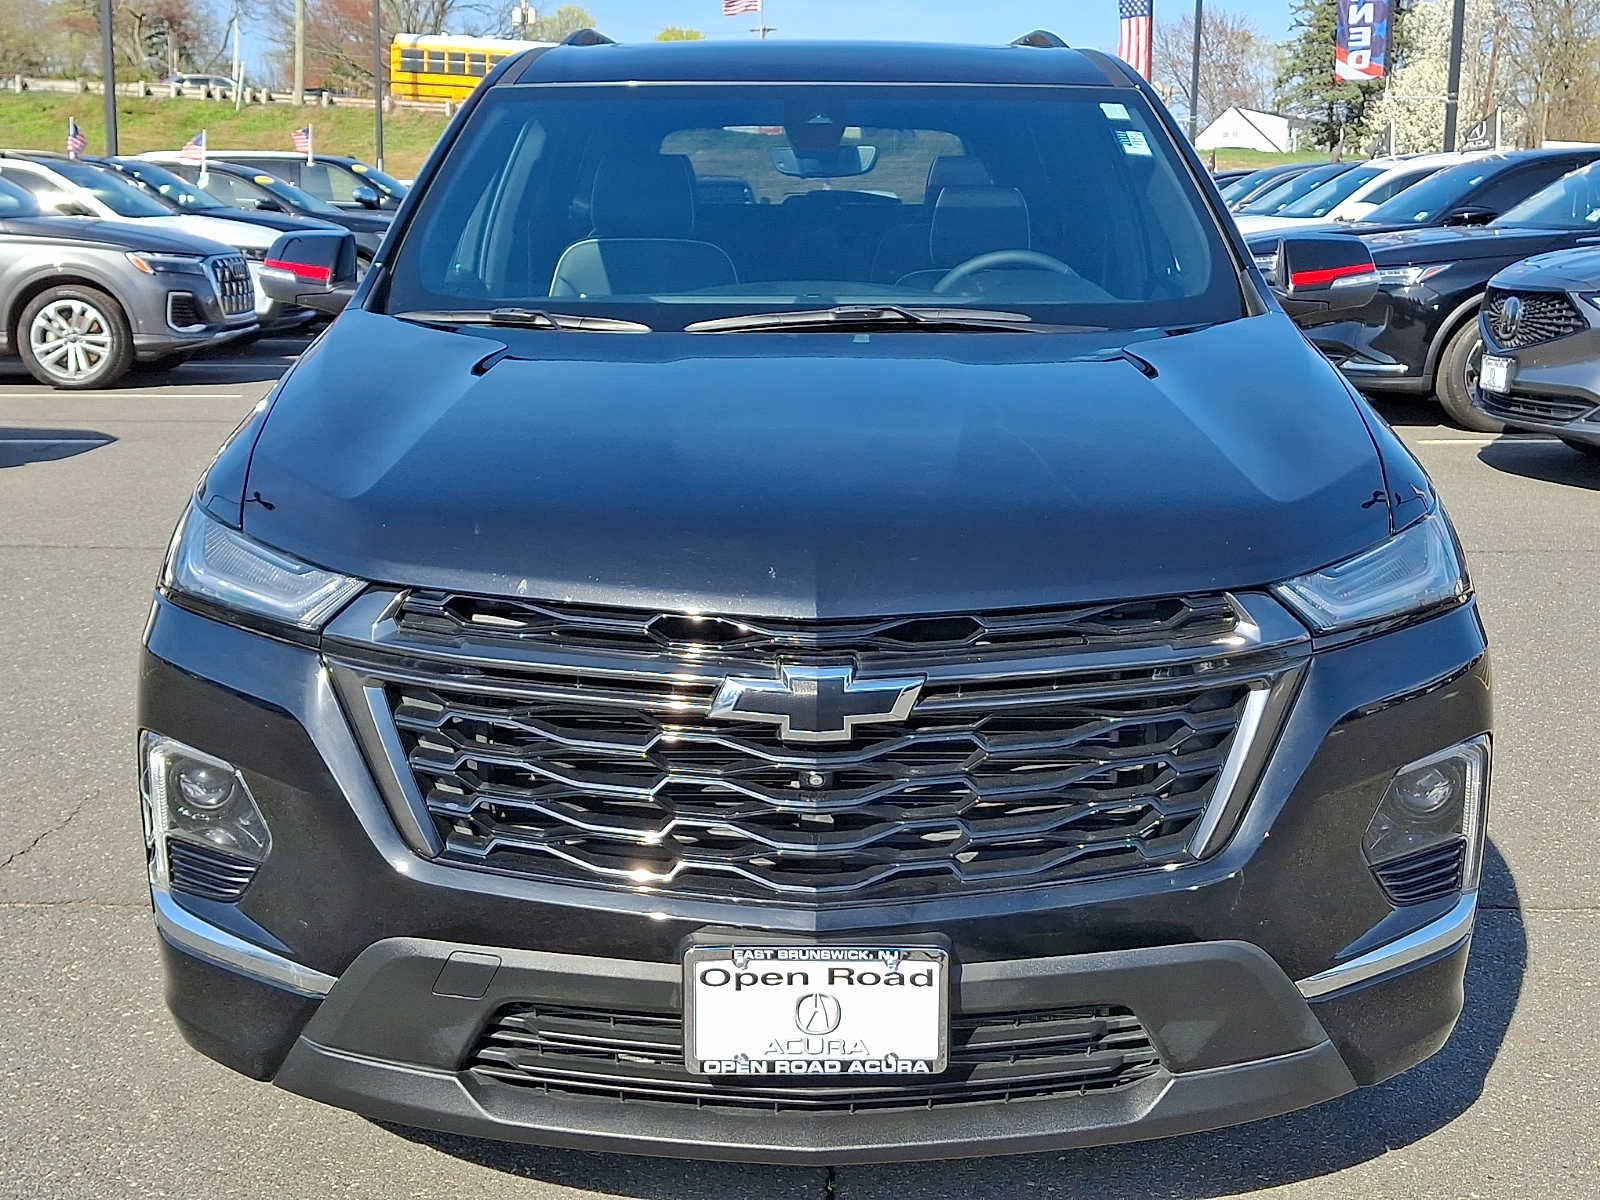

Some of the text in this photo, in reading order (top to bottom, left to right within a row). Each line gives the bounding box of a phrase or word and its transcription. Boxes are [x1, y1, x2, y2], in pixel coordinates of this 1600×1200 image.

[733, 949, 899, 960] EAST BRUNSWICK, NJ
[699, 967, 934, 991] Open Road
[763, 1038, 870, 1055] ACURA
[703, 1060, 930, 1073] OPEN ROAD ACURA
